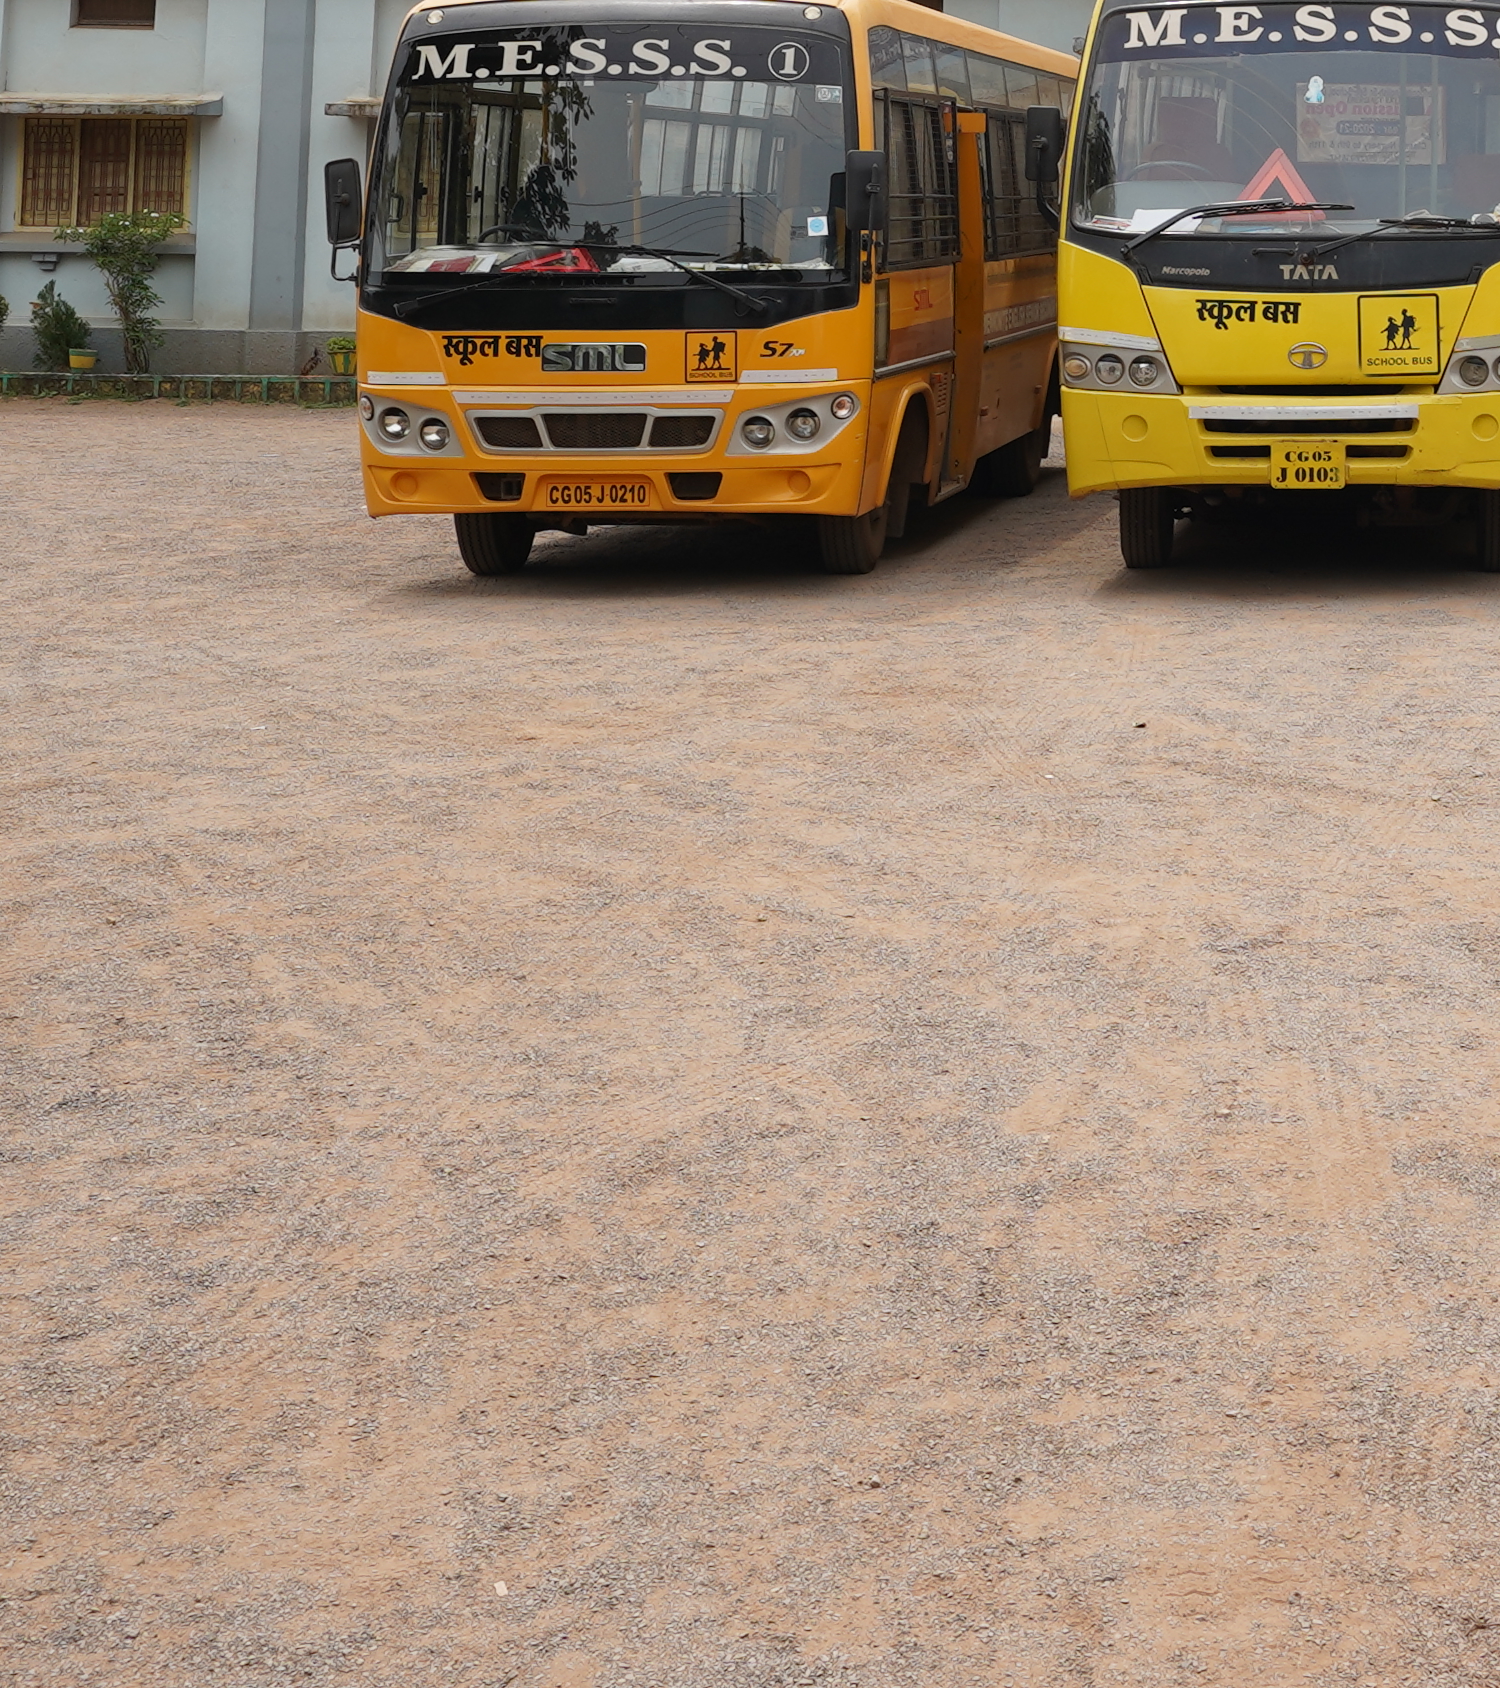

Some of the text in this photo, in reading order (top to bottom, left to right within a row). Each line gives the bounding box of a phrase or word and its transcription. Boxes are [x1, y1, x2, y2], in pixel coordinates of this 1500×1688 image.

[412, 39, 747, 79] M.E.S.S.S.
[1161, 266, 1211, 276] Marcopolo
[1279, 264, 1339, 280] TATA
[1195, 299, 1301, 330] स्कूल बस
[441, 335, 544, 366] स्कूल बस
[1367, 357, 1432, 367] SCHOOL BUS
[1295, 467, 1340, 483] 0103
